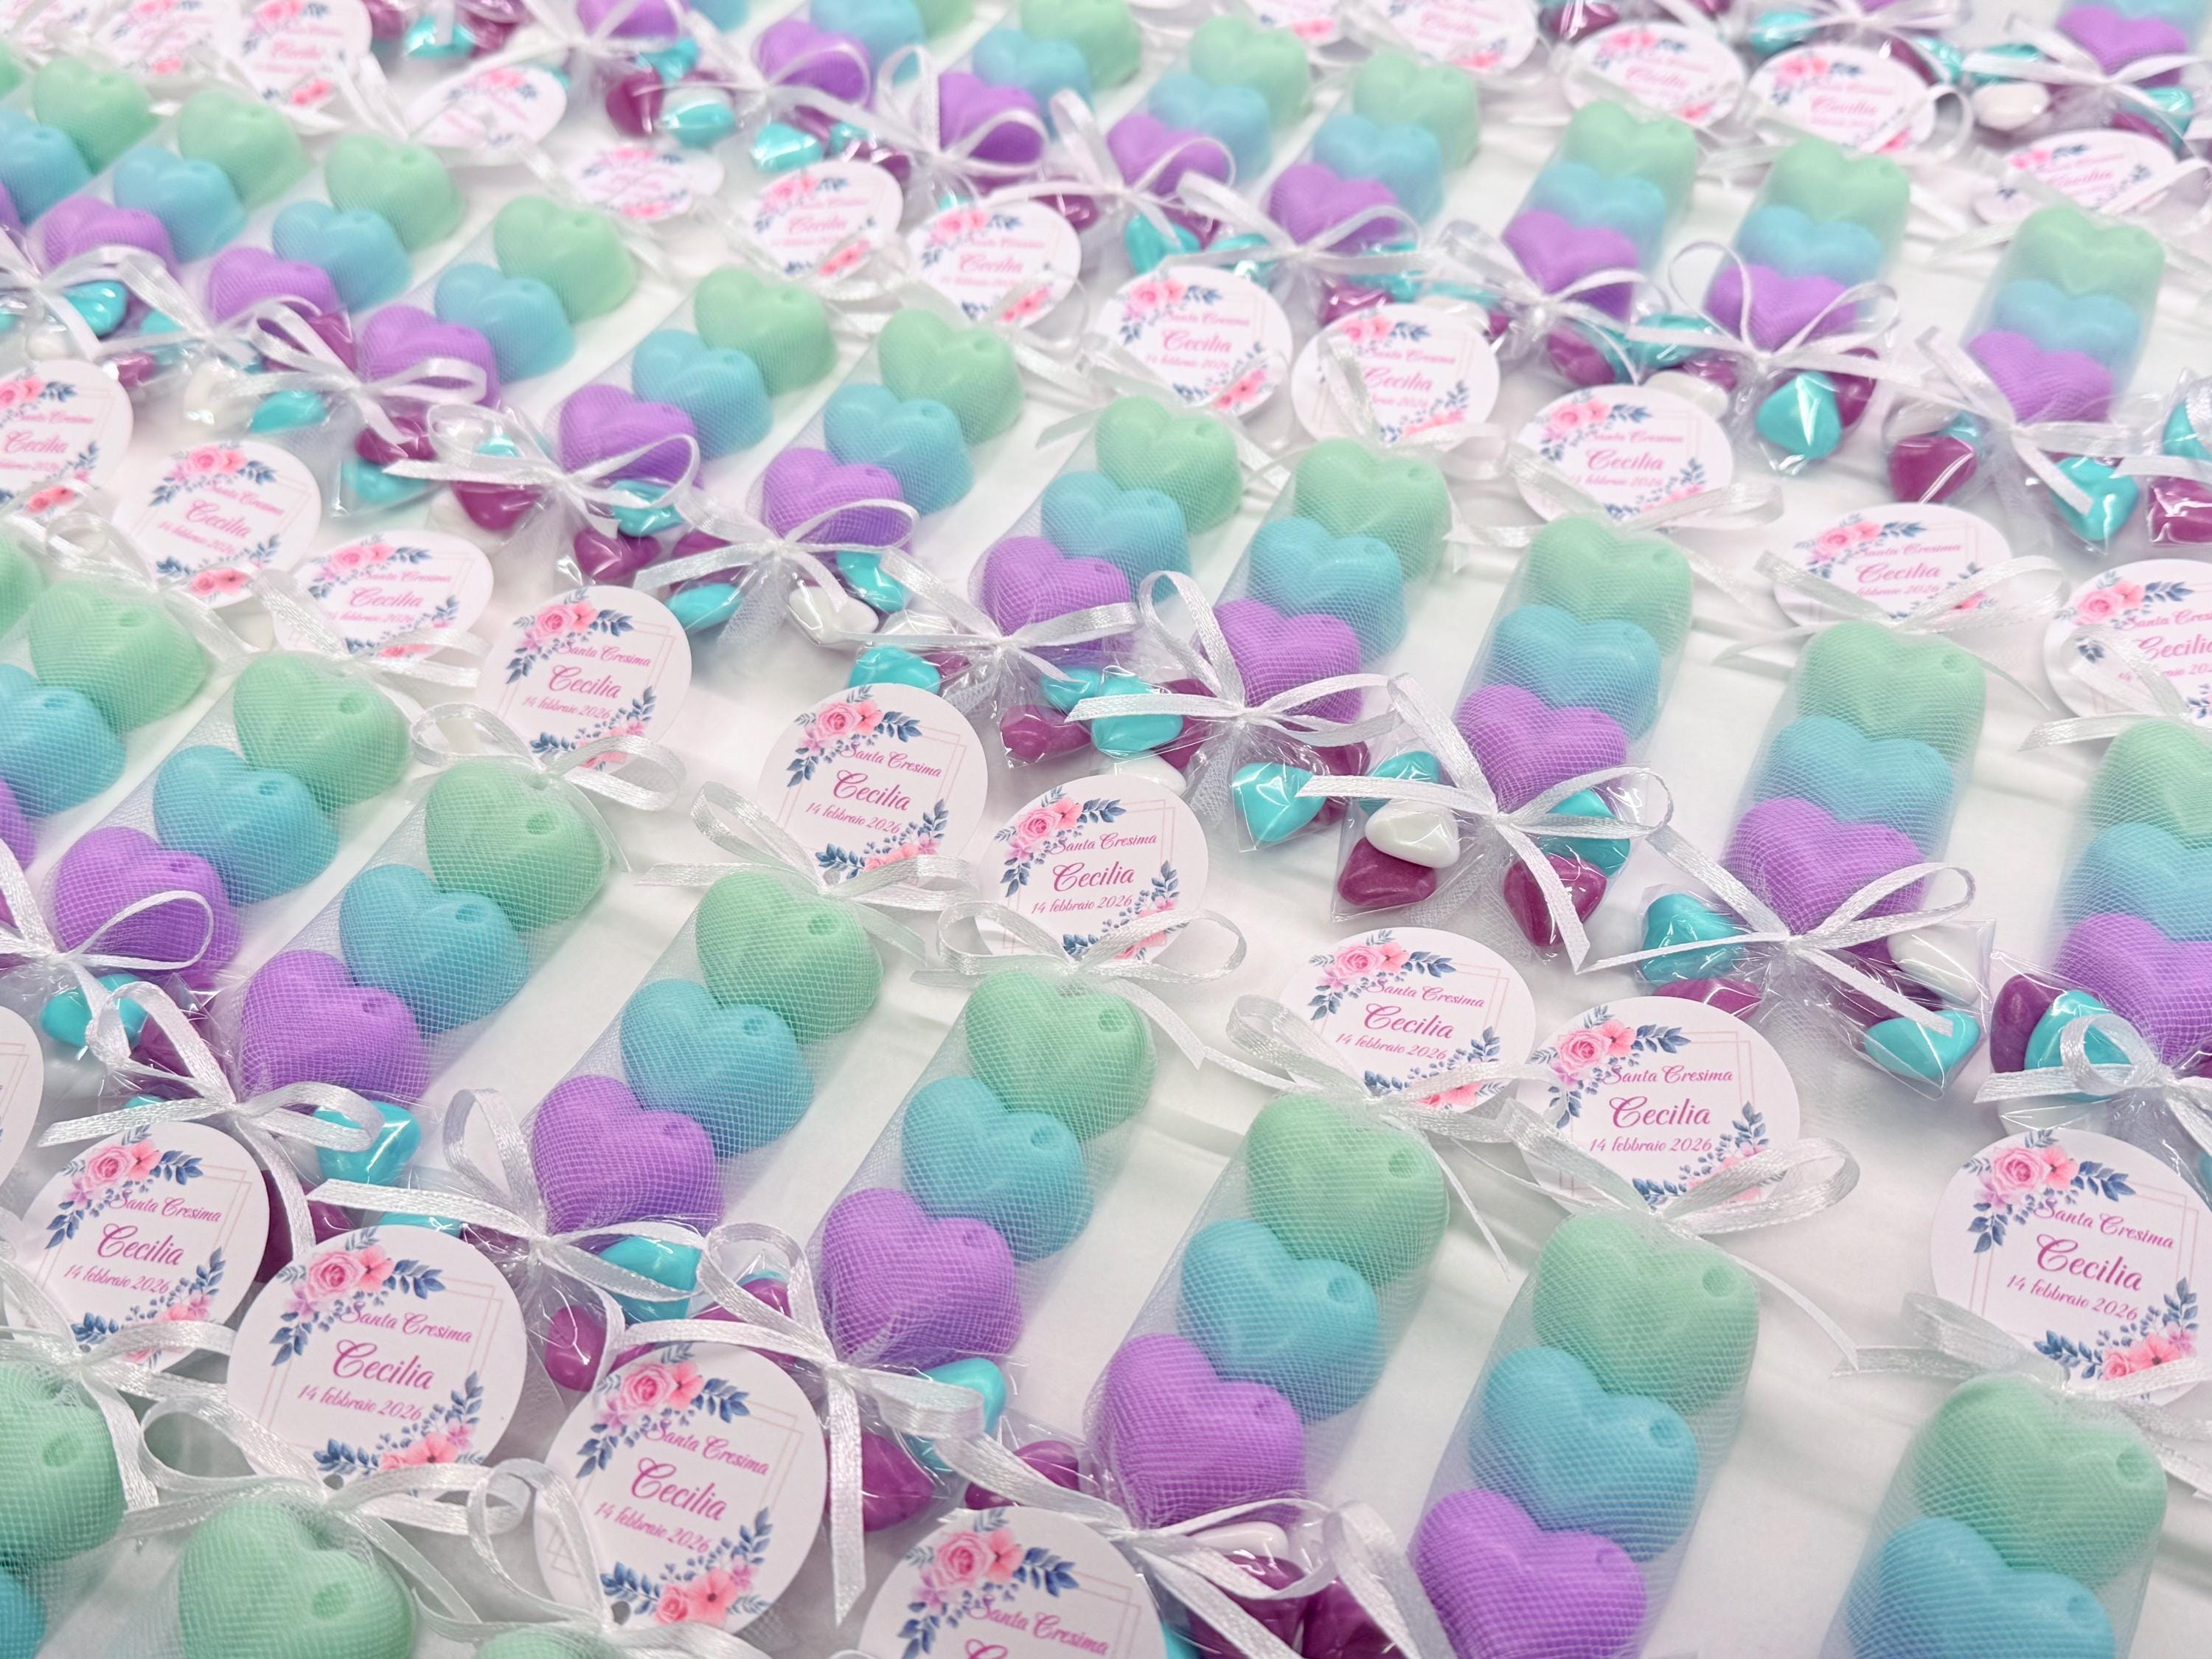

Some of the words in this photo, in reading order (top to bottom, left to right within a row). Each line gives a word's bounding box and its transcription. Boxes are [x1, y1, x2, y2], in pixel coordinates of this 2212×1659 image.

[1162, 330, 1232, 353] Cecilia
[1585, 448, 1664, 470] Cecilia
[187, 498, 252, 539] Cecilia
[1855, 562, 1941, 584] Cecilia
[349, 587, 425, 608] Cecilia
[556, 640, 597, 658] Santa
[600, 646, 651, 667] Cresima
[549, 665, 622, 699] Cecilia
[522, 696, 535, 706] 14
[538, 698, 577, 714] febbraio
[577, 706, 611, 720] 2026
[839, 742, 885, 764] Santa
[888, 751, 942, 777] Cresima
[833, 770, 911, 811] Cecilia
[805, 802, 821, 814] 14
[822, 804, 866, 826] febbraio
[866, 818, 900, 834] 2026
[1049, 836, 1096, 855] Santa
[1099, 832, 1157, 850] Cresima
[1052, 860, 1135, 892] Cecilia
[1031, 902, 1046, 914] 14
[1049, 898, 1095, 913] febbraio
[1096, 894, 1133, 908] 2026
[1366, 978, 1417, 998] Santa
[1422, 986, 1486, 1008] Cresima
[1363, 1003, 1455, 1039] Cecilia
[1335, 1033, 1351, 1046] 14
[1354, 1035, 1405, 1054] febbraio
[1406, 1045, 1447, 1060] 2026
[1602, 1065, 1658, 1085] Santa
[1662, 1065, 1733, 1084] Cresima
[1609, 1096, 1711, 1128] Cecilia
[1589, 1138, 1607, 1152] 14
[1611, 1136, 1666, 1152] febbraio
[1668, 1137, 1712, 1152] 2026
[109, 1189, 159, 1213] Santa
[161, 1197, 222, 1222] Cresima
[2033, 1198, 2093, 1228] Santa
[2099, 1213, 2174, 1249] Cresima
[97, 1223, 184, 1265] Cecilia
[2037, 1234, 2142, 1291] Cecilia
[63, 1265, 80, 1279] 14
[82, 1266, 131, 1288] febbraio
[131, 1275, 170, 1294] 2026
[2006, 1274, 2026, 1290] 14
[2029, 1279, 2090, 1308] febbraio
[2092, 1298, 2138, 1321] 2026
[339, 1301, 398, 1329] Santa
[402, 1312, 473, 1344] Cresima
[333, 1339, 435, 1391] Cecilia
[296, 1384, 317, 1400] 14
[319, 1386, 377, 1413] febbraio
[378, 1400, 422, 1421] 2026
[644, 1419, 700, 1453] Santa
[702, 1435, 770, 1475] Cresima
[630, 1457, 728, 1522] Cecilia
[594, 1501, 614, 1520] 14
[615, 1506, 668, 1537] febbraio
[667, 1526, 714, 1554] 2026
[966, 1593, 1029, 1631] Santa
[1032, 1611, 1109, 1656] Cresima
